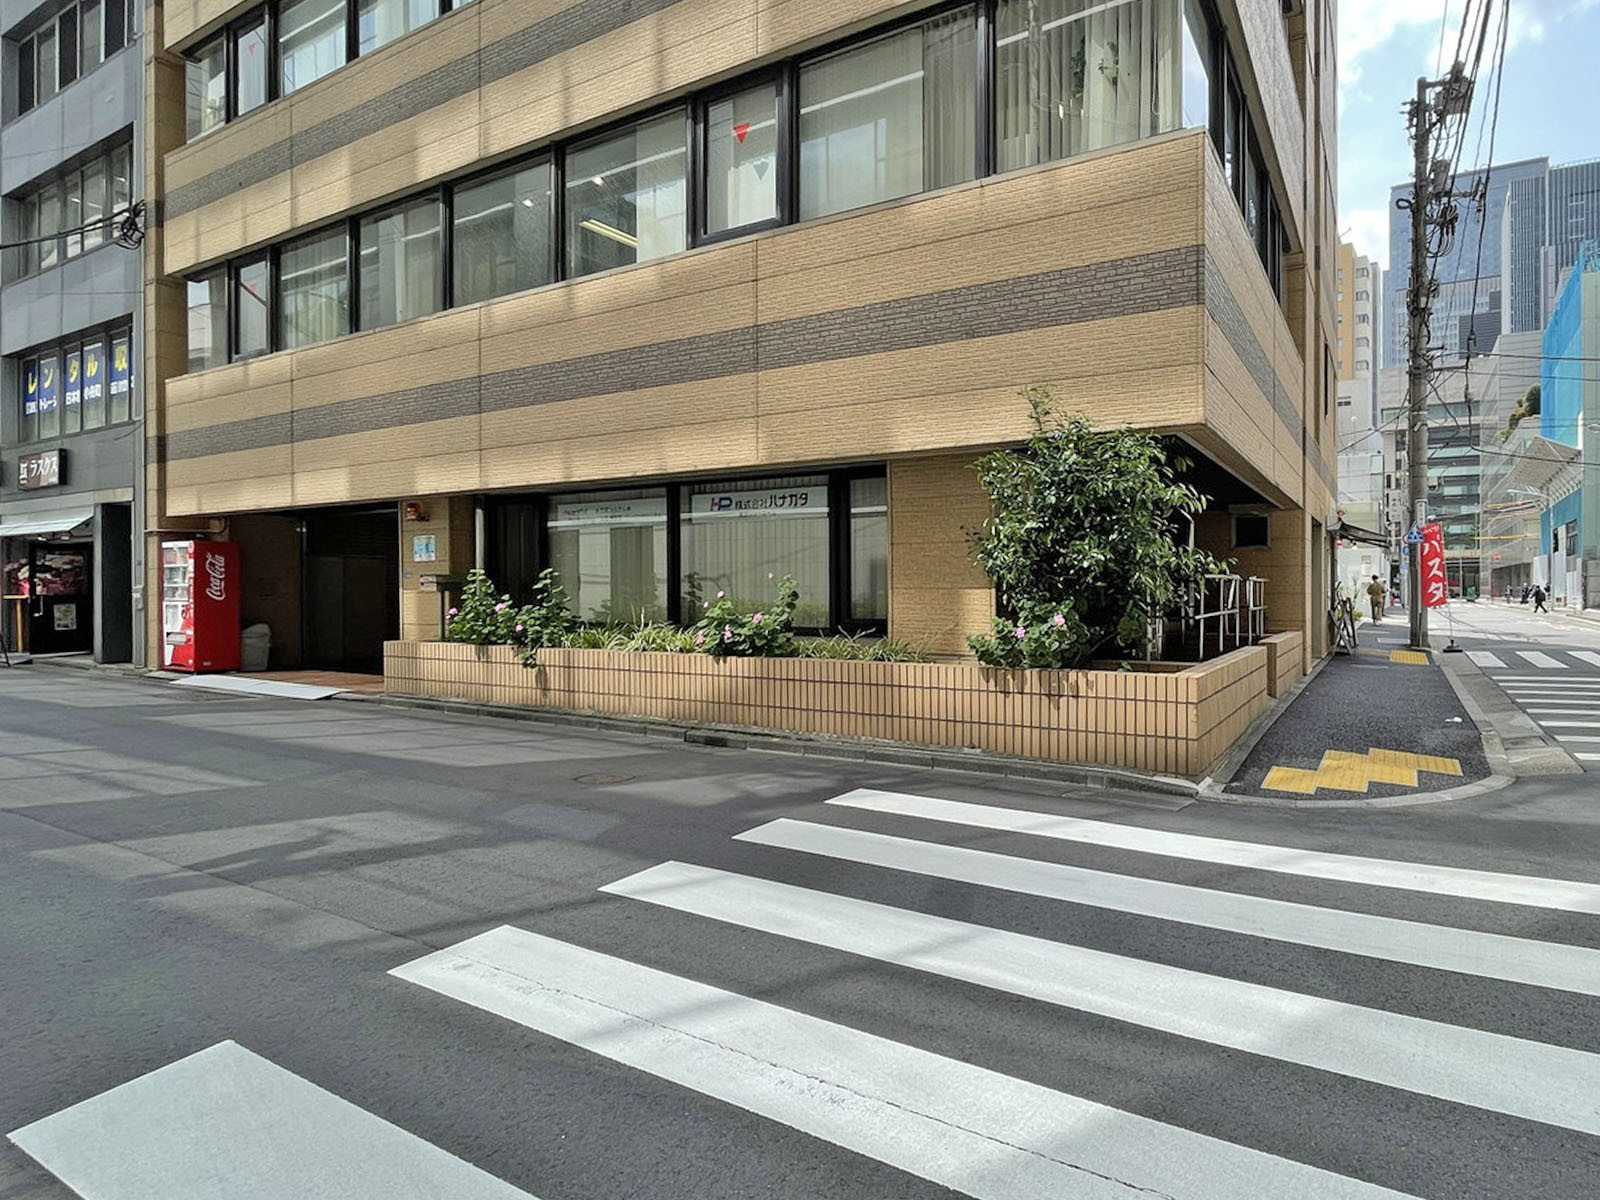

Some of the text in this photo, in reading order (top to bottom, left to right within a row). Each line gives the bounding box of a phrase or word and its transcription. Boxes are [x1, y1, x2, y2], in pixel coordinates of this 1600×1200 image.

[206, 552, 225, 601] Coca-Cola
[1423, 534, 1443, 603] パスタ
